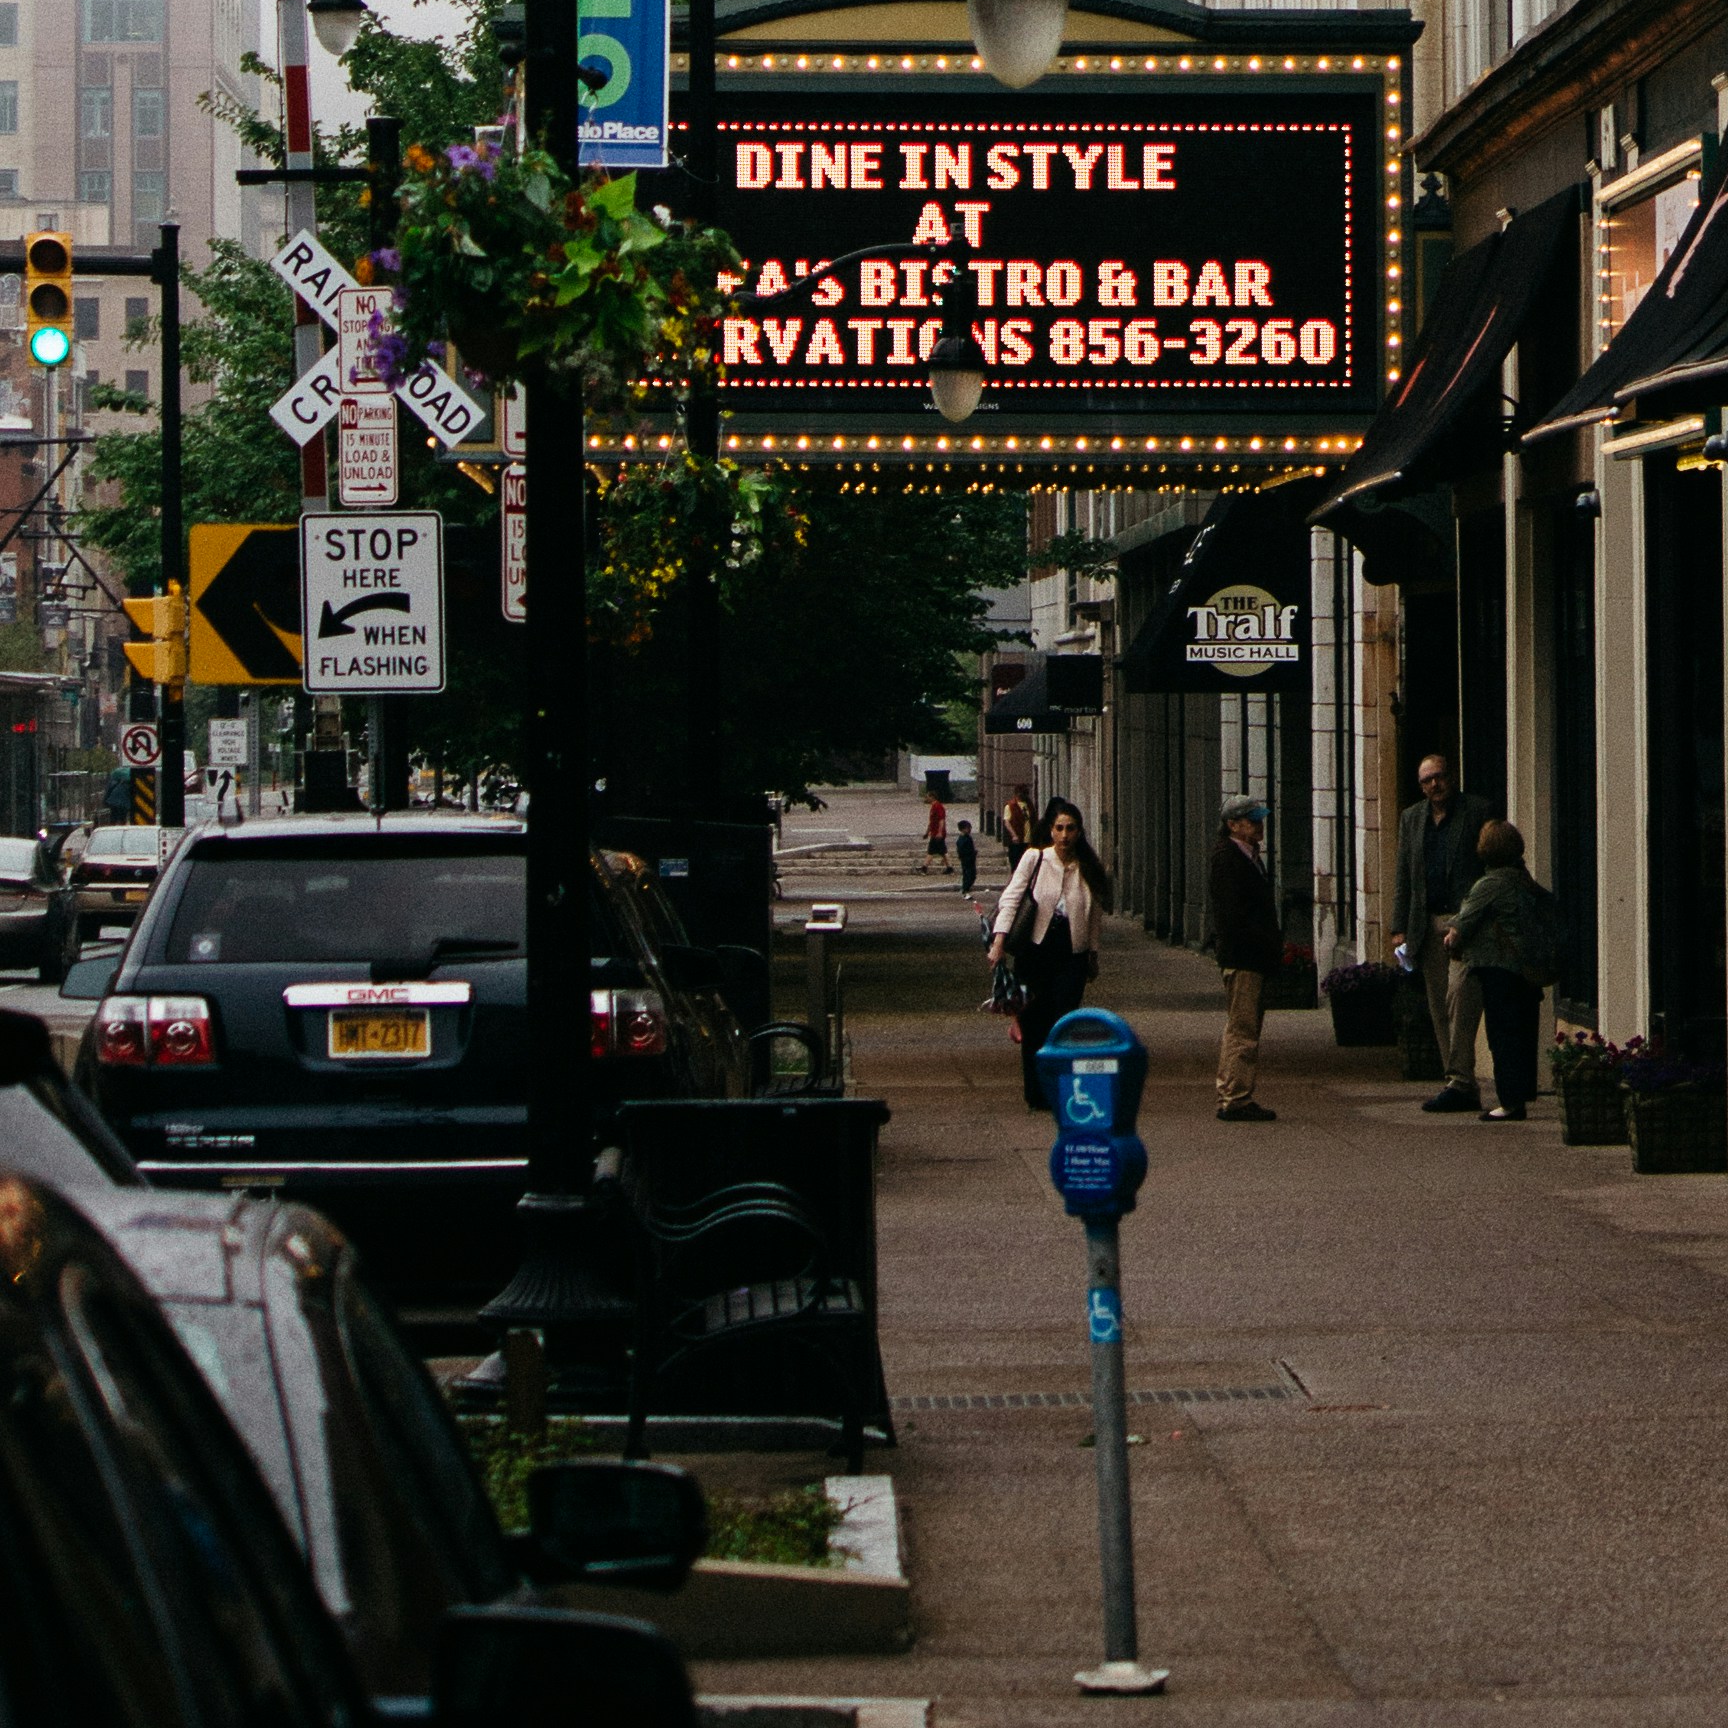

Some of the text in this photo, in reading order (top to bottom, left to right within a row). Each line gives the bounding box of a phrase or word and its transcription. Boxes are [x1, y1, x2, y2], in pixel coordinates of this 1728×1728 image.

[603, 121, 659, 139] Place
[736, 143, 1178, 191] DINE IN STYLE
[912, 201, 991, 248] AT
[1097, 260, 1137, 307] &
[1153, 260, 1274, 307] BAR
[356, 295, 377, 315] NO
[282, 241, 341, 318] RAI
[408, 373, 471, 435] OAD
[1049, 319, 1337, 366] 856-3260
[342, 404, 392, 424] NO PARKING
[346, 433, 389, 447] 15 MINUTE
[345, 449, 390, 463] LOAD &
[344, 466, 393, 480] UNLOAD
[506, 478, 526, 506] NO
[325, 528, 418, 562] STOP
[343, 568, 401, 589] HERE
[1221, 596, 1258, 611] THE
[1186, 604, 1299, 640] Tralf
[364, 624, 426, 646] WHEN
[1189, 647, 1296, 659] MUSIC HALL
[320, 656, 428, 678] FLASHING
[347, 987, 409, 1002] GMC
